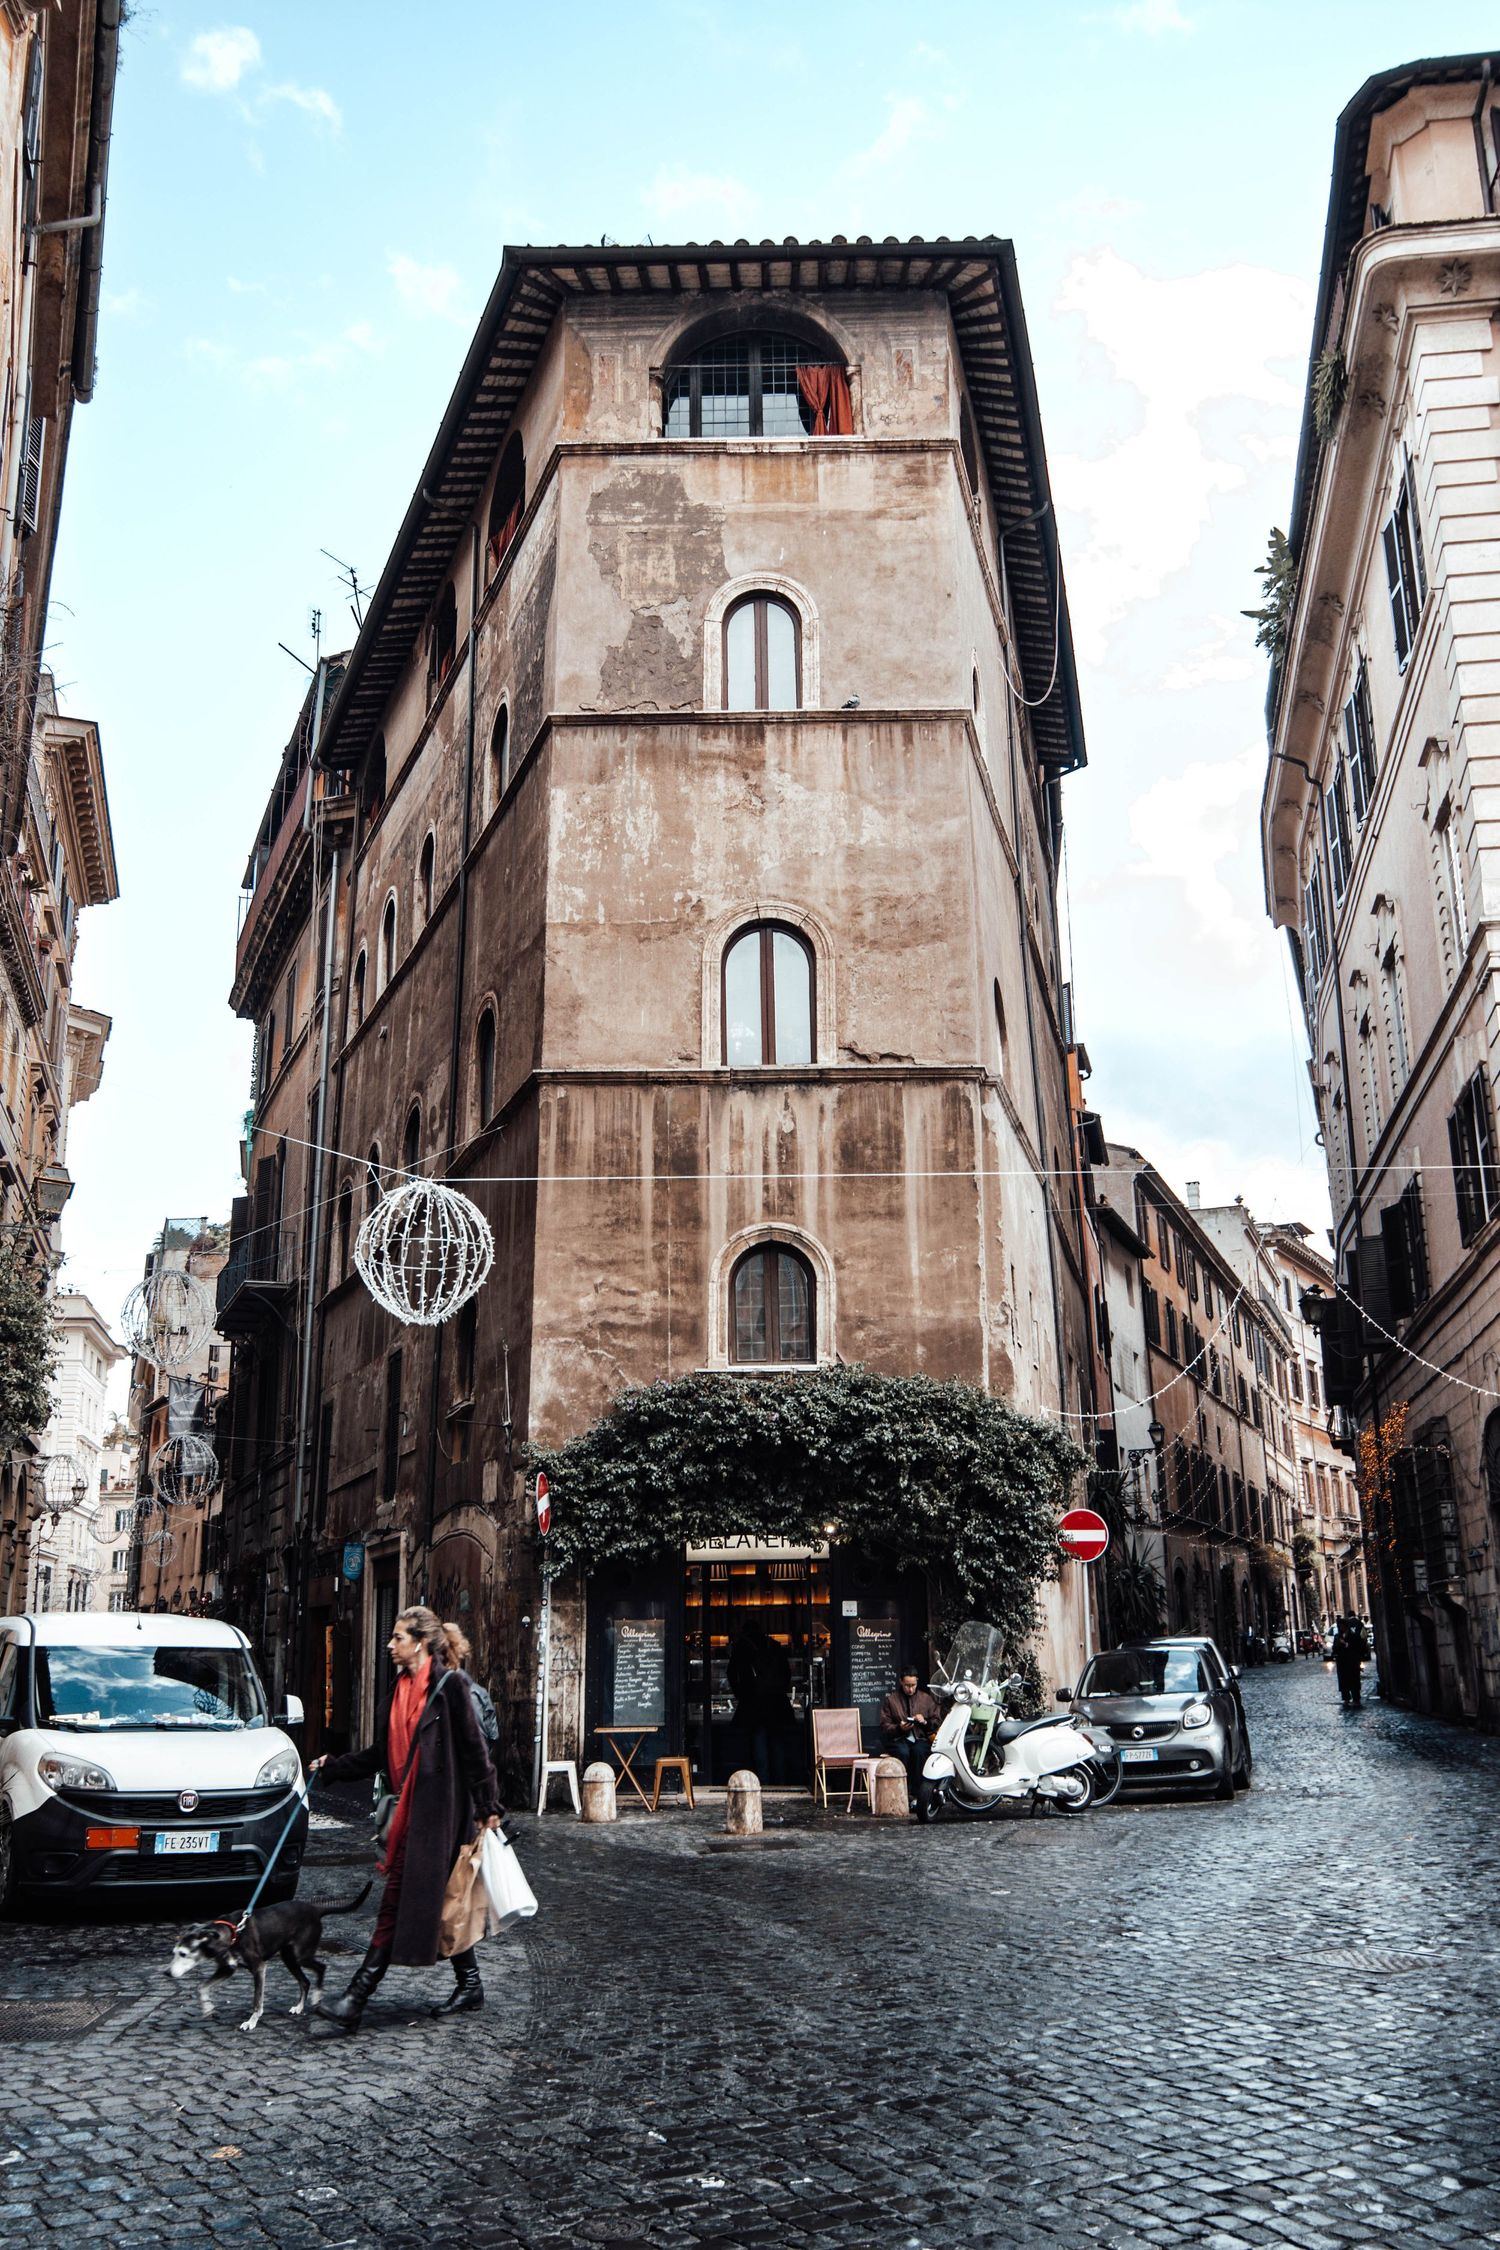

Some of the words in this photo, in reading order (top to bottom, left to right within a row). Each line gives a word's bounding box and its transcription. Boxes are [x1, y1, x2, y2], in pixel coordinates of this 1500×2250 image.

[691, 1533, 820, 1551] GELATER
[621, 1626, 656, 1642] Pellegrino
[857, 1626, 892, 1642] Pellegrino
[183, 1796, 195, 1806] FIAT
[164, 1838, 177, 1849] FE
[180, 1837, 209, 1849] 235VT
